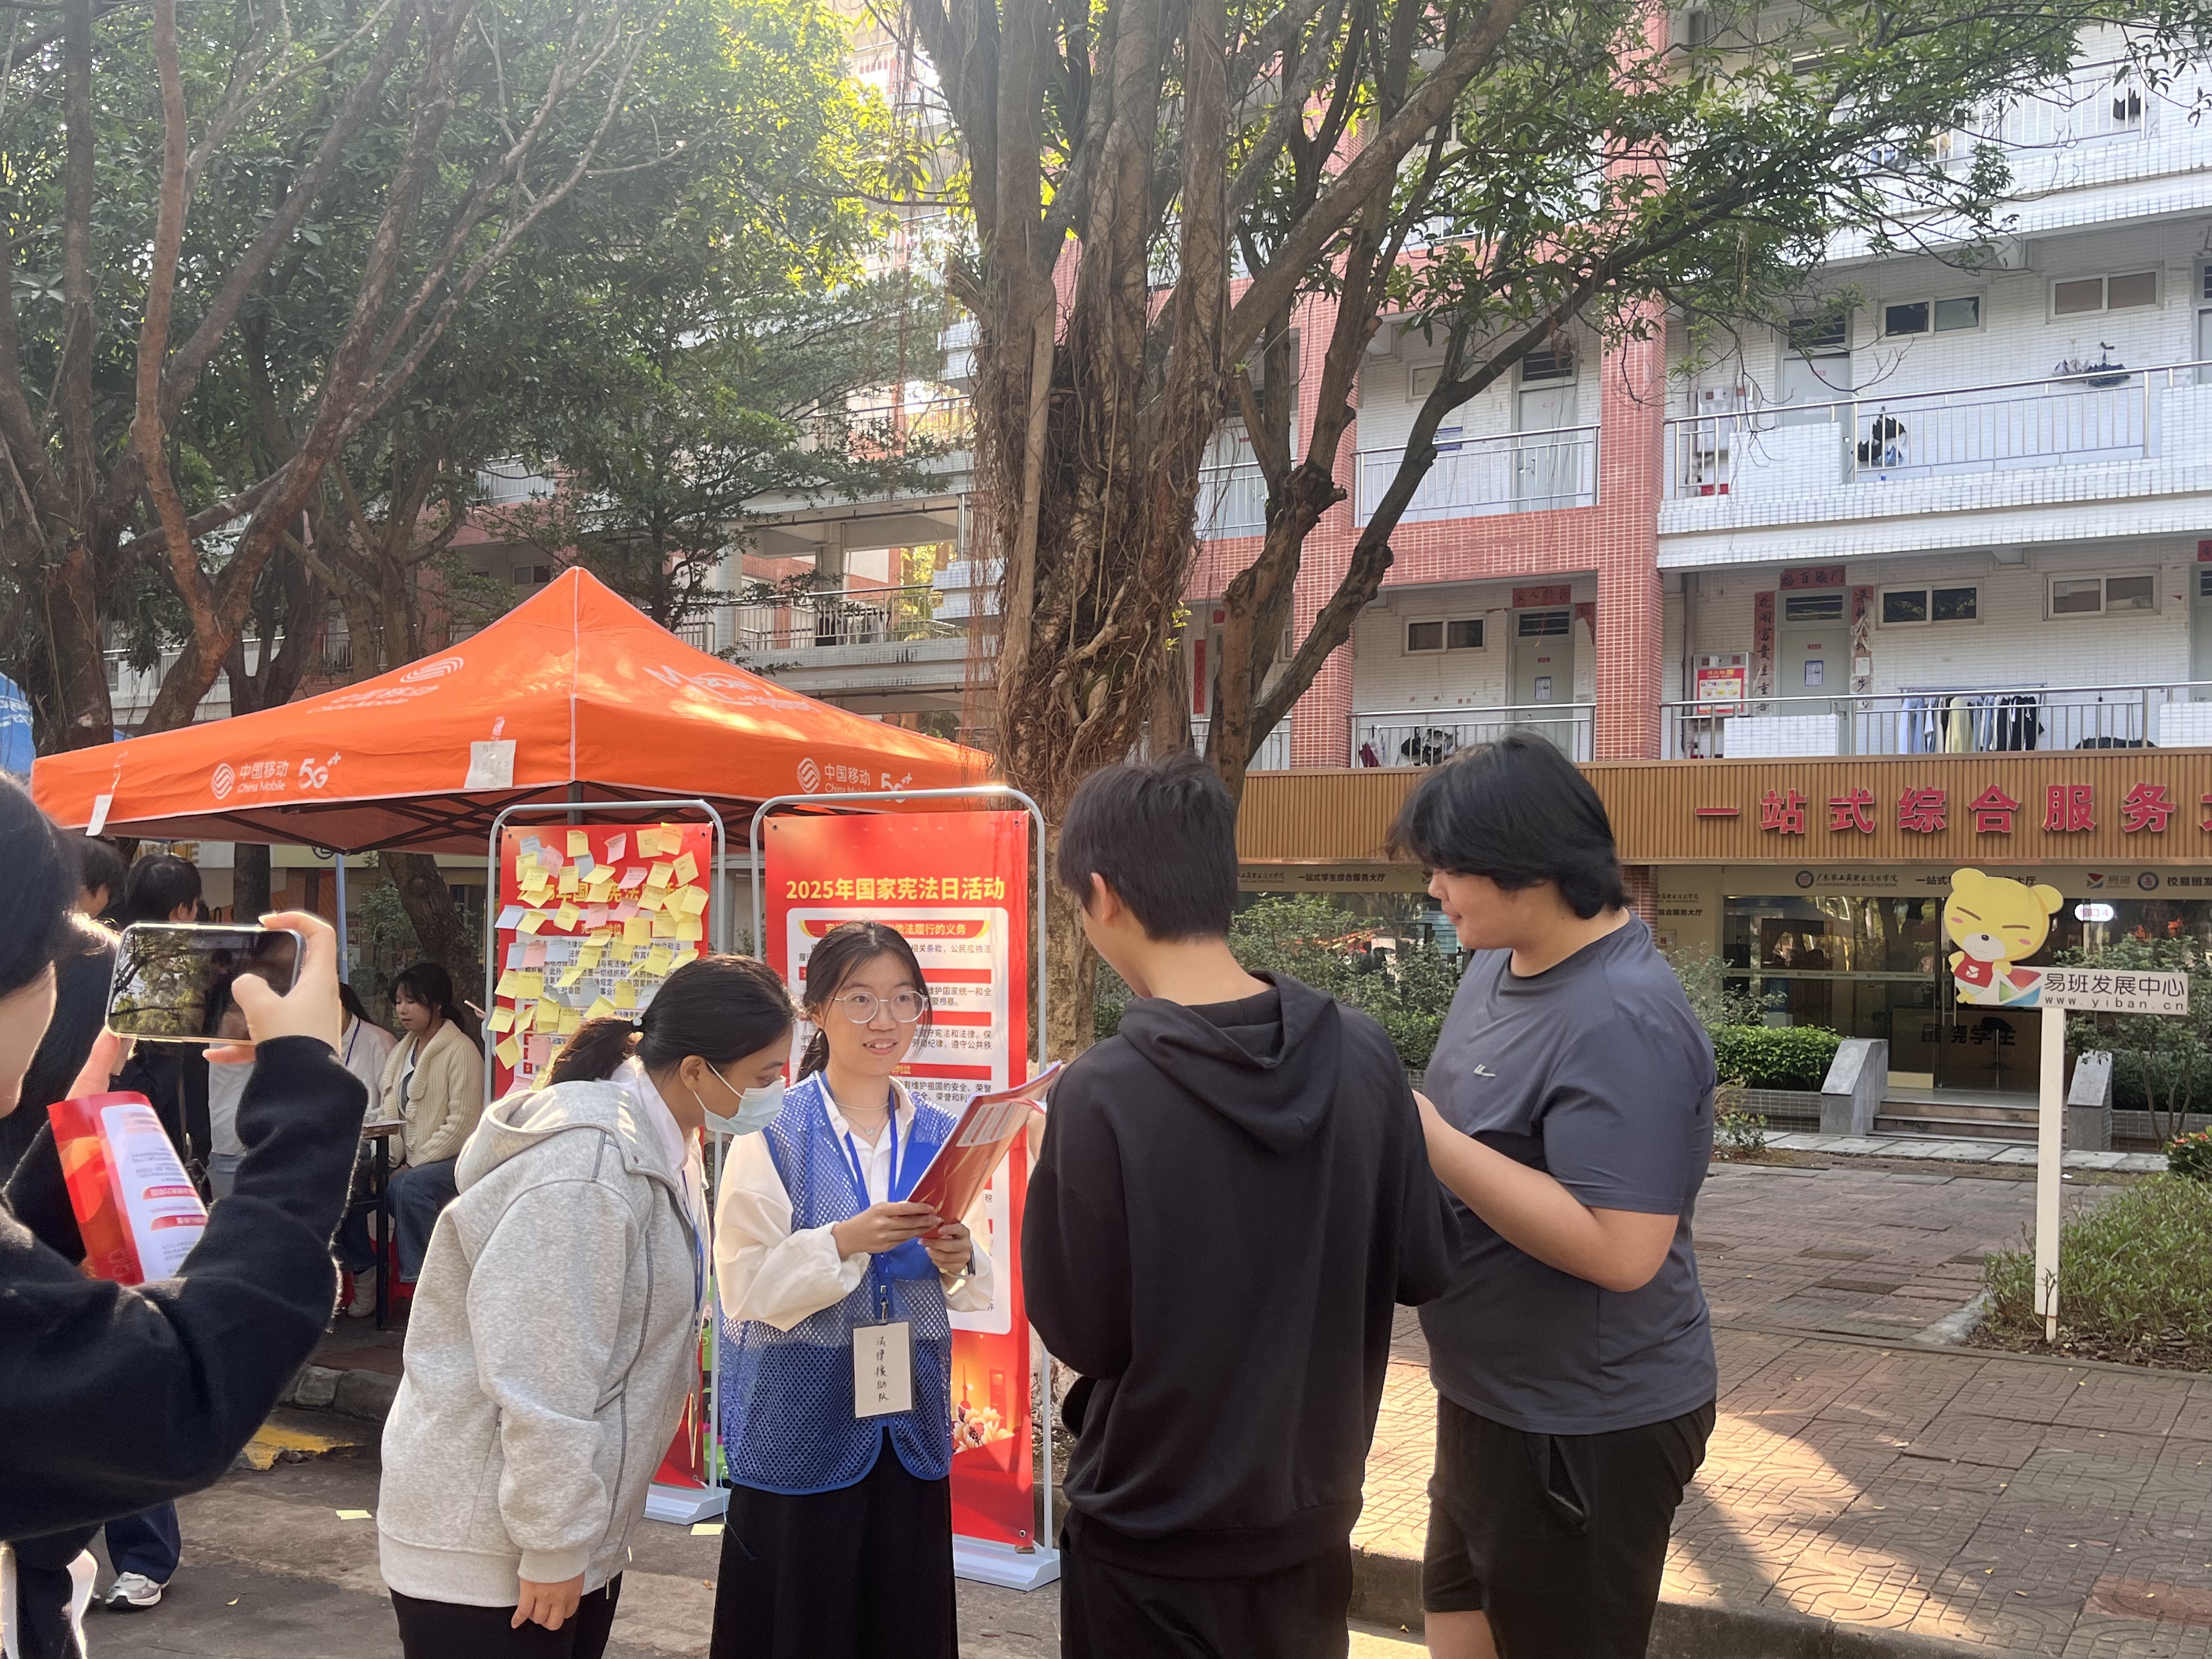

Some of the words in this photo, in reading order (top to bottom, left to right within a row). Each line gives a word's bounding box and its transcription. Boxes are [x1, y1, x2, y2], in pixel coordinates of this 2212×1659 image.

[239, 760, 290, 780] 中国移动
[824, 763, 871, 786] 中国移动
[237, 782, 258, 793] China
[259, 779, 286, 792] Mobile
[1695, 782, 2212, 834] 一站式综合服务
[786, 877, 1006, 901] 2025年国家宪法日活动
[2044, 973, 2185, 997] 易班发展中心
[2045, 996, 2184, 1011] www.yiban.cn
[913, 1091, 972, 1103] 安全、荣誉和利
